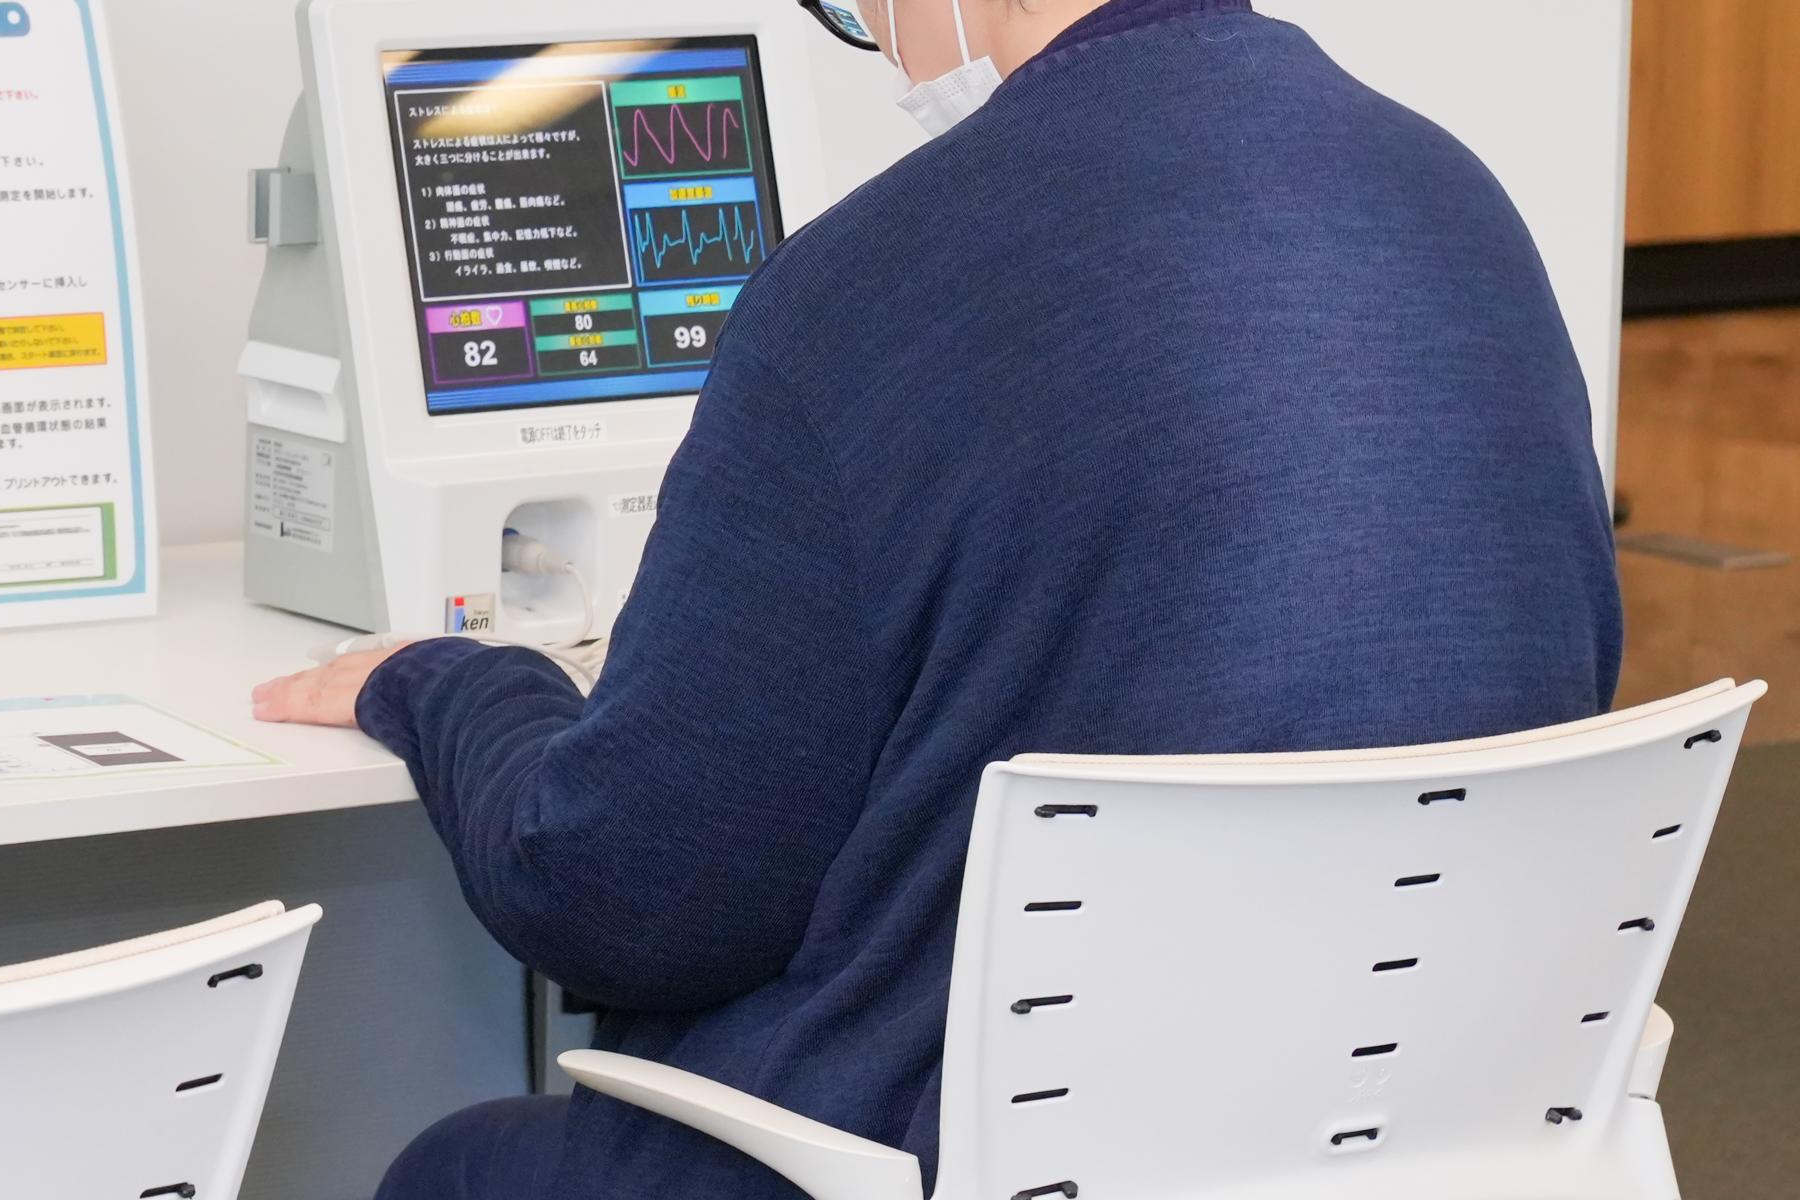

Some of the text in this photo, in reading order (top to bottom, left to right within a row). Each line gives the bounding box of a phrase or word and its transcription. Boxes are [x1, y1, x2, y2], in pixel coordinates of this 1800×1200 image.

[574, 314, 593, 331] 80
[674, 325, 707, 349] 99
[463, 340, 498, 367] 82
[579, 350, 598, 367] 64
